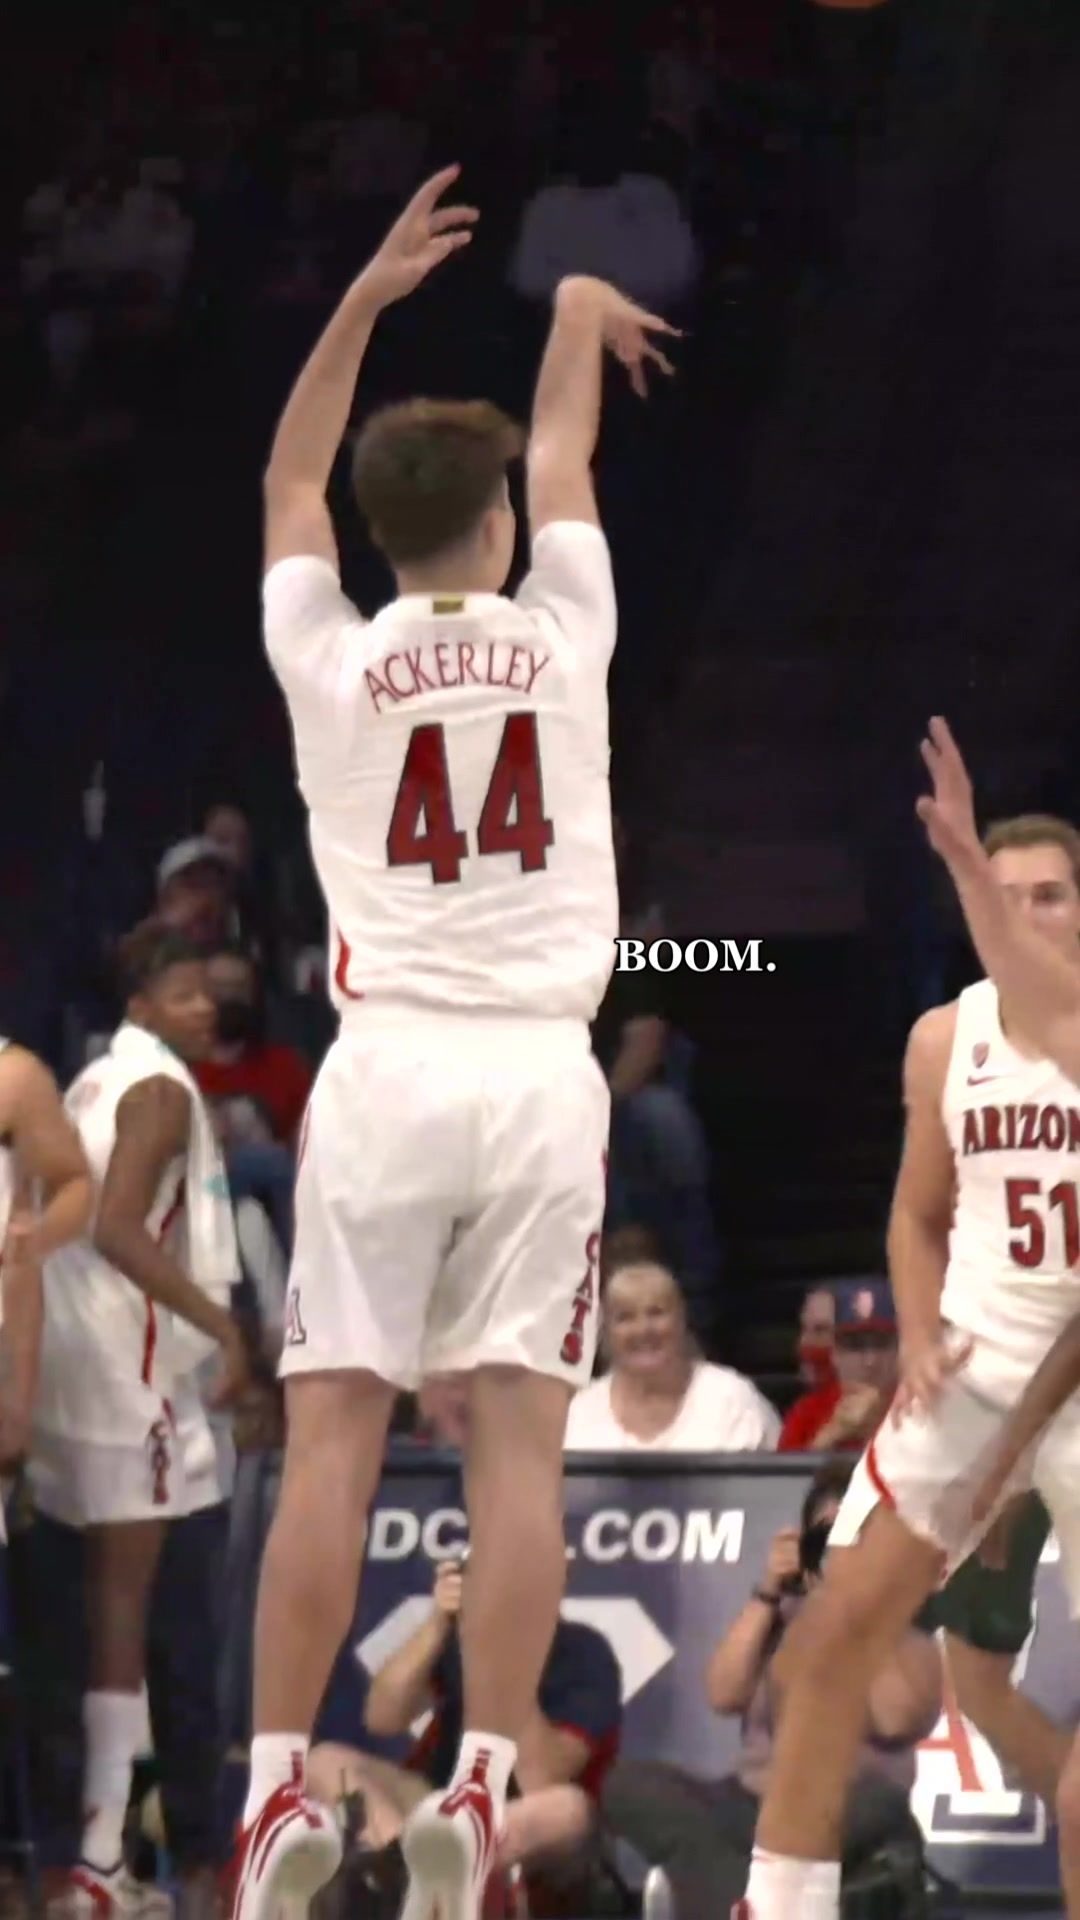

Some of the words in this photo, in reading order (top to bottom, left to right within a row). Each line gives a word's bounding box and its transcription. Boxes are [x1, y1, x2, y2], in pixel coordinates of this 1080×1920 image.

[364, 641, 549, 714] ACKERLEY
[386, 710, 555, 885] 44
[1004, 1177, 1080, 1269] 51
